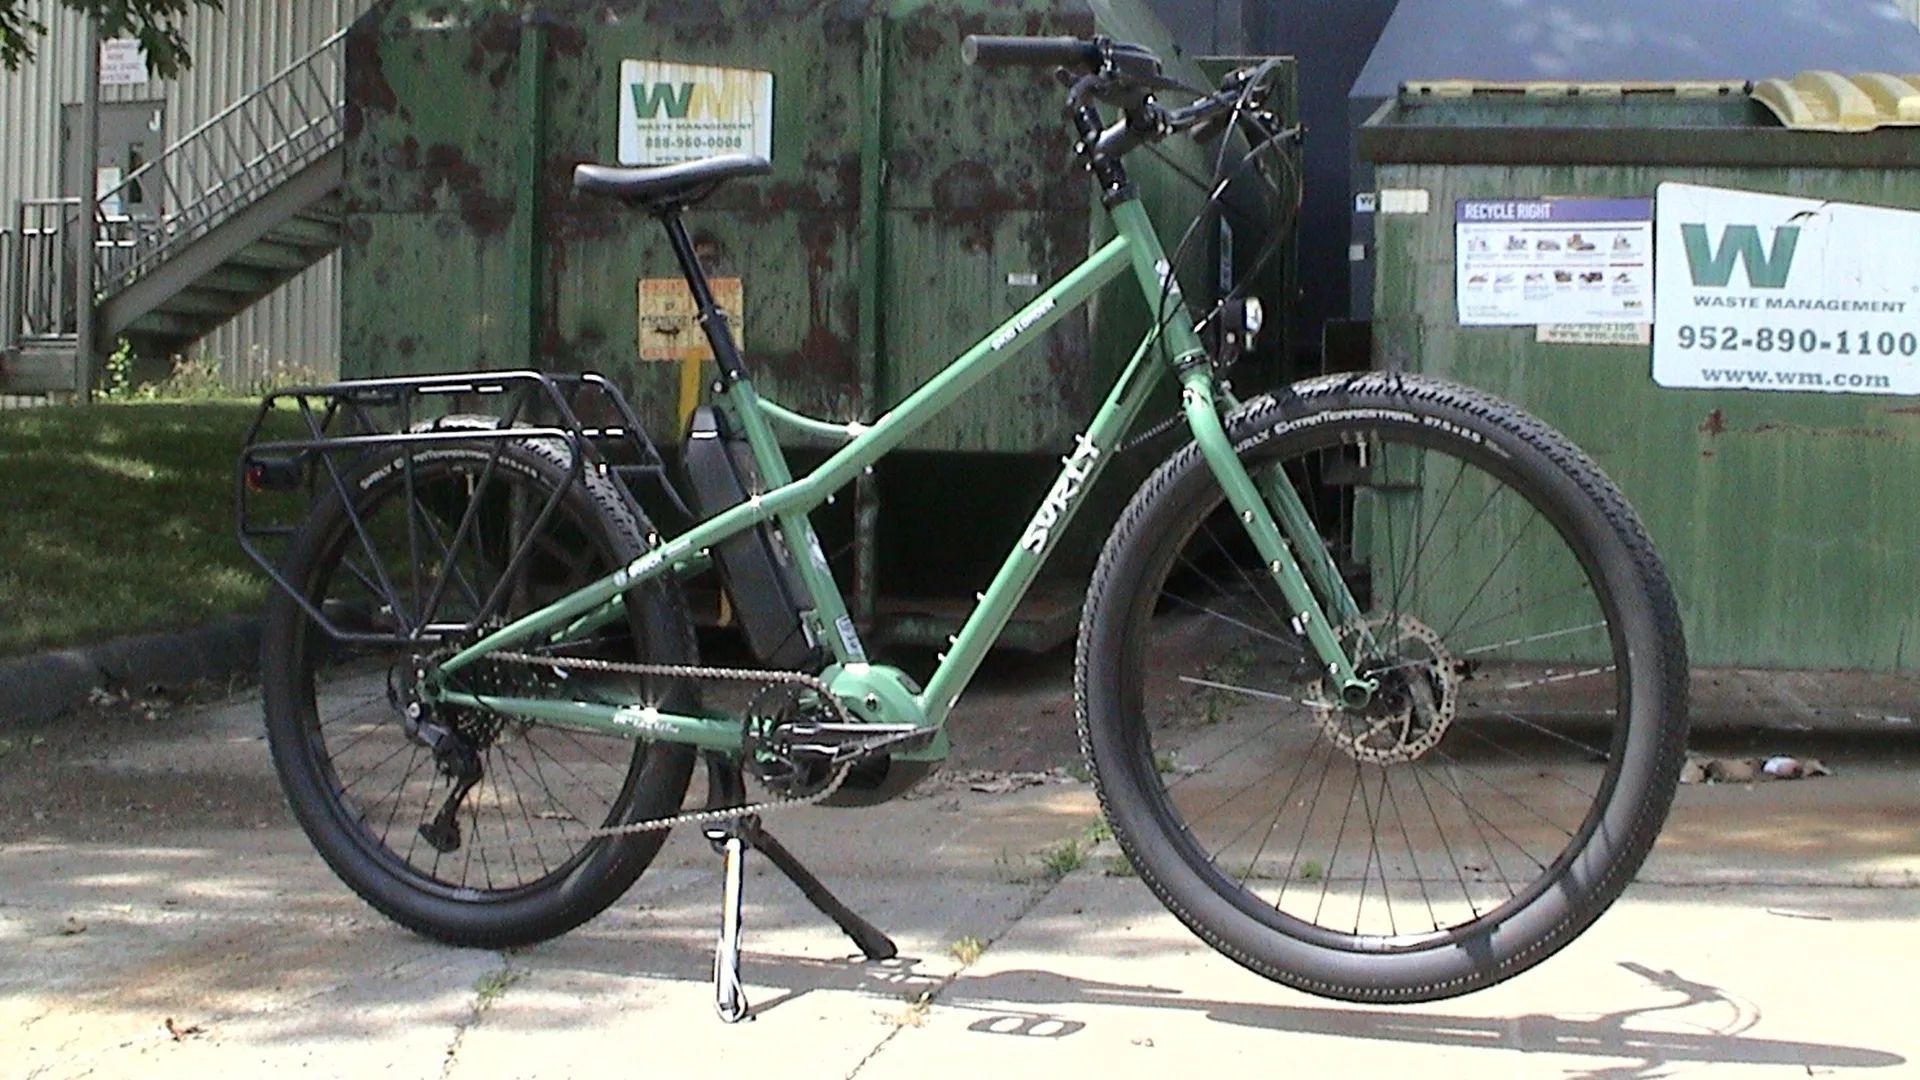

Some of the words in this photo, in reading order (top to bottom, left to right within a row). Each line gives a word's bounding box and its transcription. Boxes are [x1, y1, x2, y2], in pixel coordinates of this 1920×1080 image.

[637, 123, 672, 131] WASTE
[676, 123, 751, 132] MANAGEMENT
[1464, 203, 1515, 219] RECYCLE
[1517, 203, 1552, 219] RIGHT
[1693, 296, 1760, 309] WASTE
[1765, 299, 1907, 313] MANAGEMENT
[1678, 325, 1918, 357] 952-890-1100
[1701, 368, 1890, 389] www.wm.com
[1021, 433, 1100, 555] SURLY
